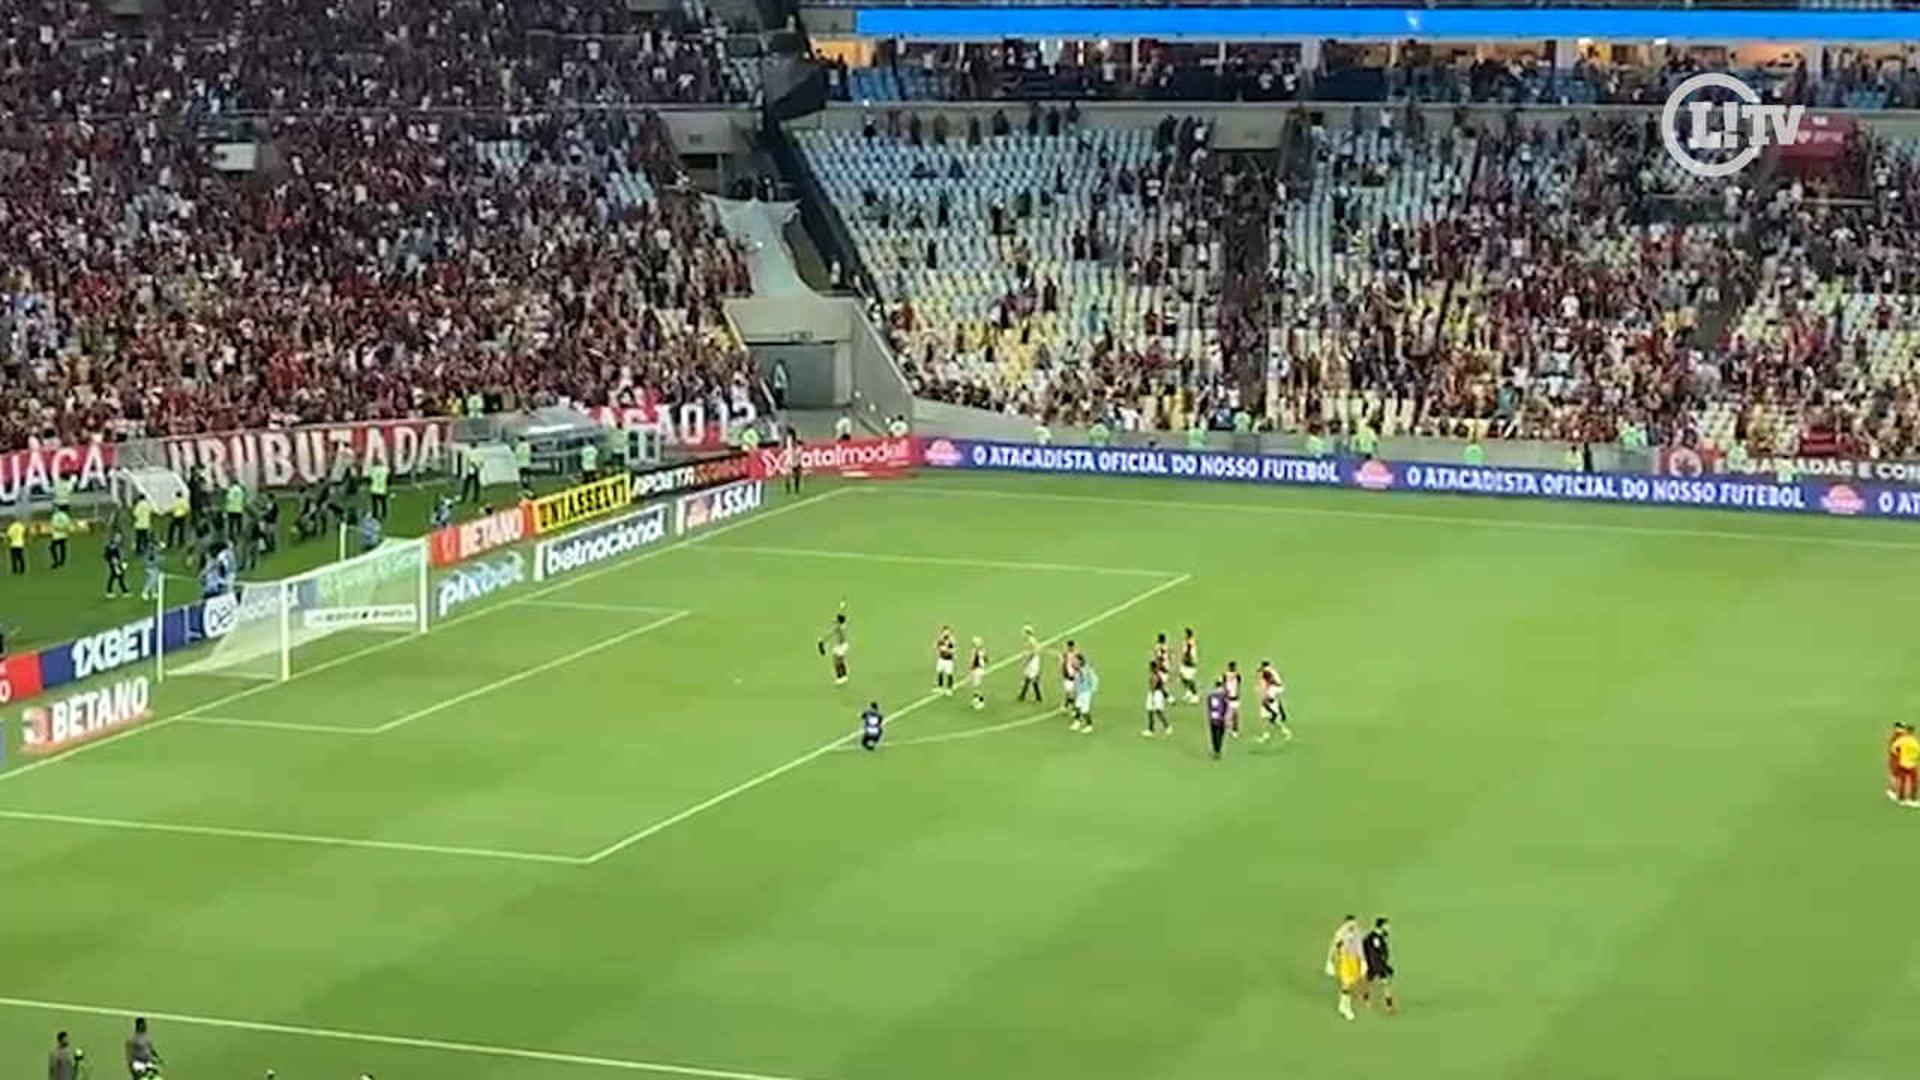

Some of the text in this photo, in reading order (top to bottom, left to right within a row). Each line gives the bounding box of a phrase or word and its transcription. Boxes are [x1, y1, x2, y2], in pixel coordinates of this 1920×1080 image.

[973, 446, 987, 465] O
[989, 447, 1095, 470] ATACADISTA
[1098, 451, 1167, 473] OFICIAL
[1172, 455, 1196, 474] DO
[1200, 456, 1258, 478] NOSSO
[1263, 459, 1340, 482] FUTEBOL
[1407, 466, 1421, 486] O
[1424, 467, 1538, 493] ATACADISTA
[1541, 475, 1617, 498] OFICIAL
[1622, 479, 1648, 499] DO
[1652, 480, 1715, 502] NOSSO
[1719, 483, 1805, 508] FUTEBOL
[1878, 492, 1894, 512] O
[547, 508, 665, 574] betnacional
[72, 616, 154, 678] 1XBET
[52, 676, 149, 743] BETANO
